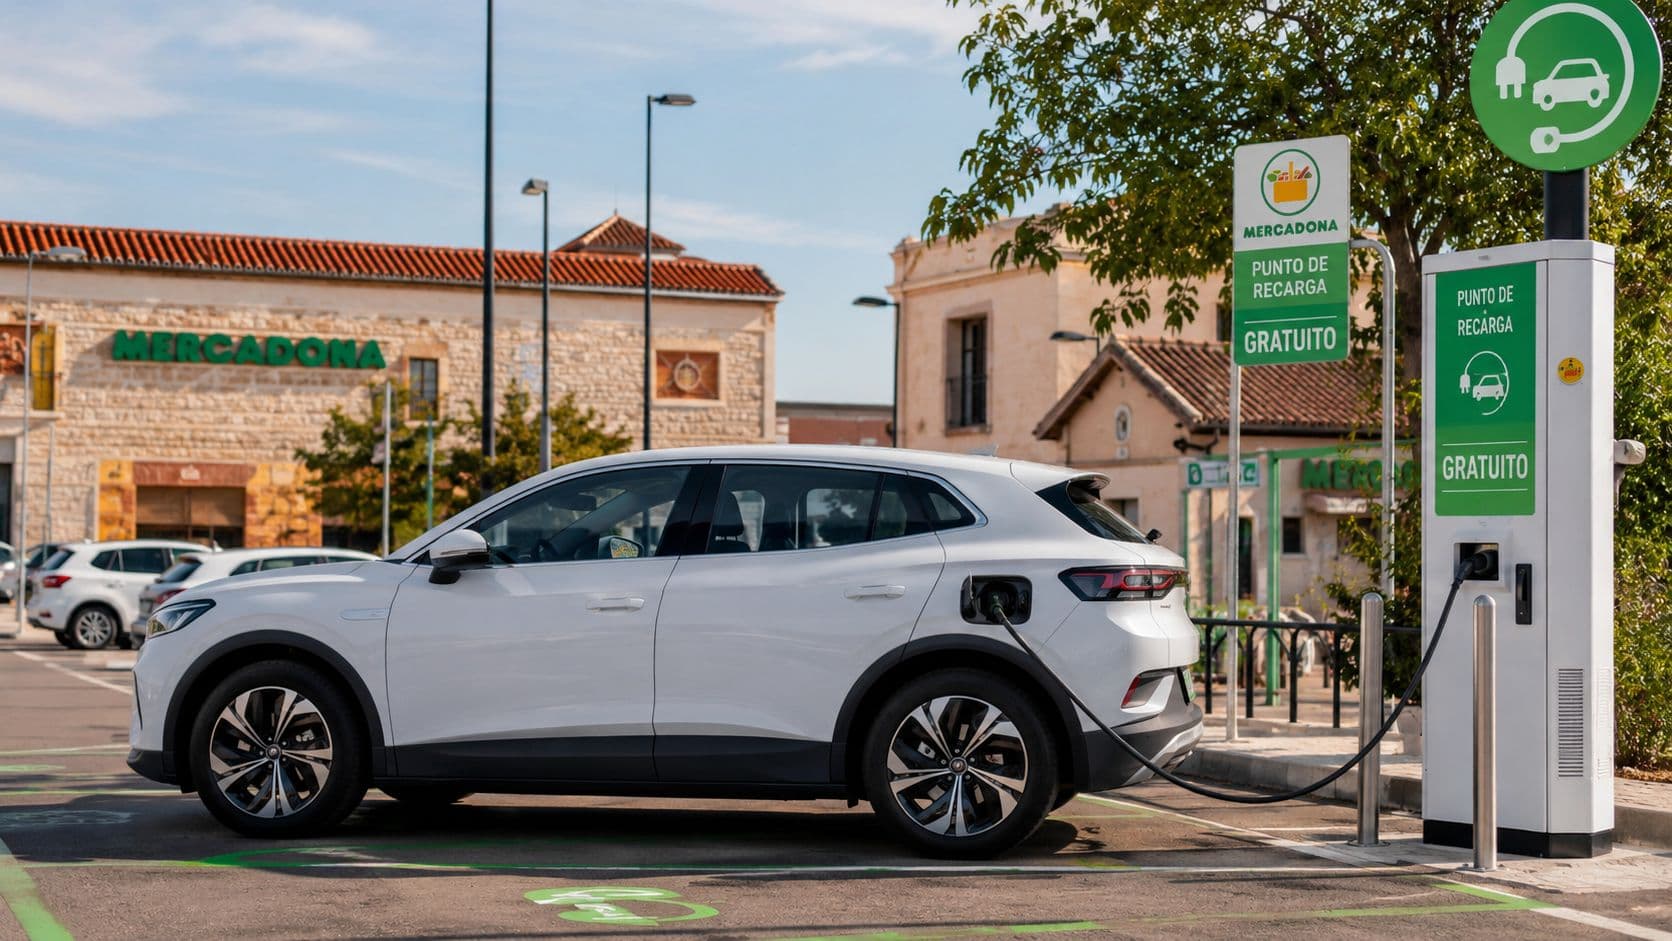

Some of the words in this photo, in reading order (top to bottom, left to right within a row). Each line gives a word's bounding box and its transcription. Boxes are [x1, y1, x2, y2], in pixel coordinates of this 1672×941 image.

[1243, 219, 1338, 239] MERCADONA
[1252, 258, 1304, 277] PUNTO
[1308, 255, 1329, 273] DE
[1253, 278, 1328, 299] RECARGA
[1457, 287, 1496, 307] PUNTO
[1498, 285, 1514, 303] DE
[112, 329, 386, 369] MERCADONA
[1244, 326, 1337, 354] GRATUITO
[1442, 453, 1529, 481] GRATUITO
